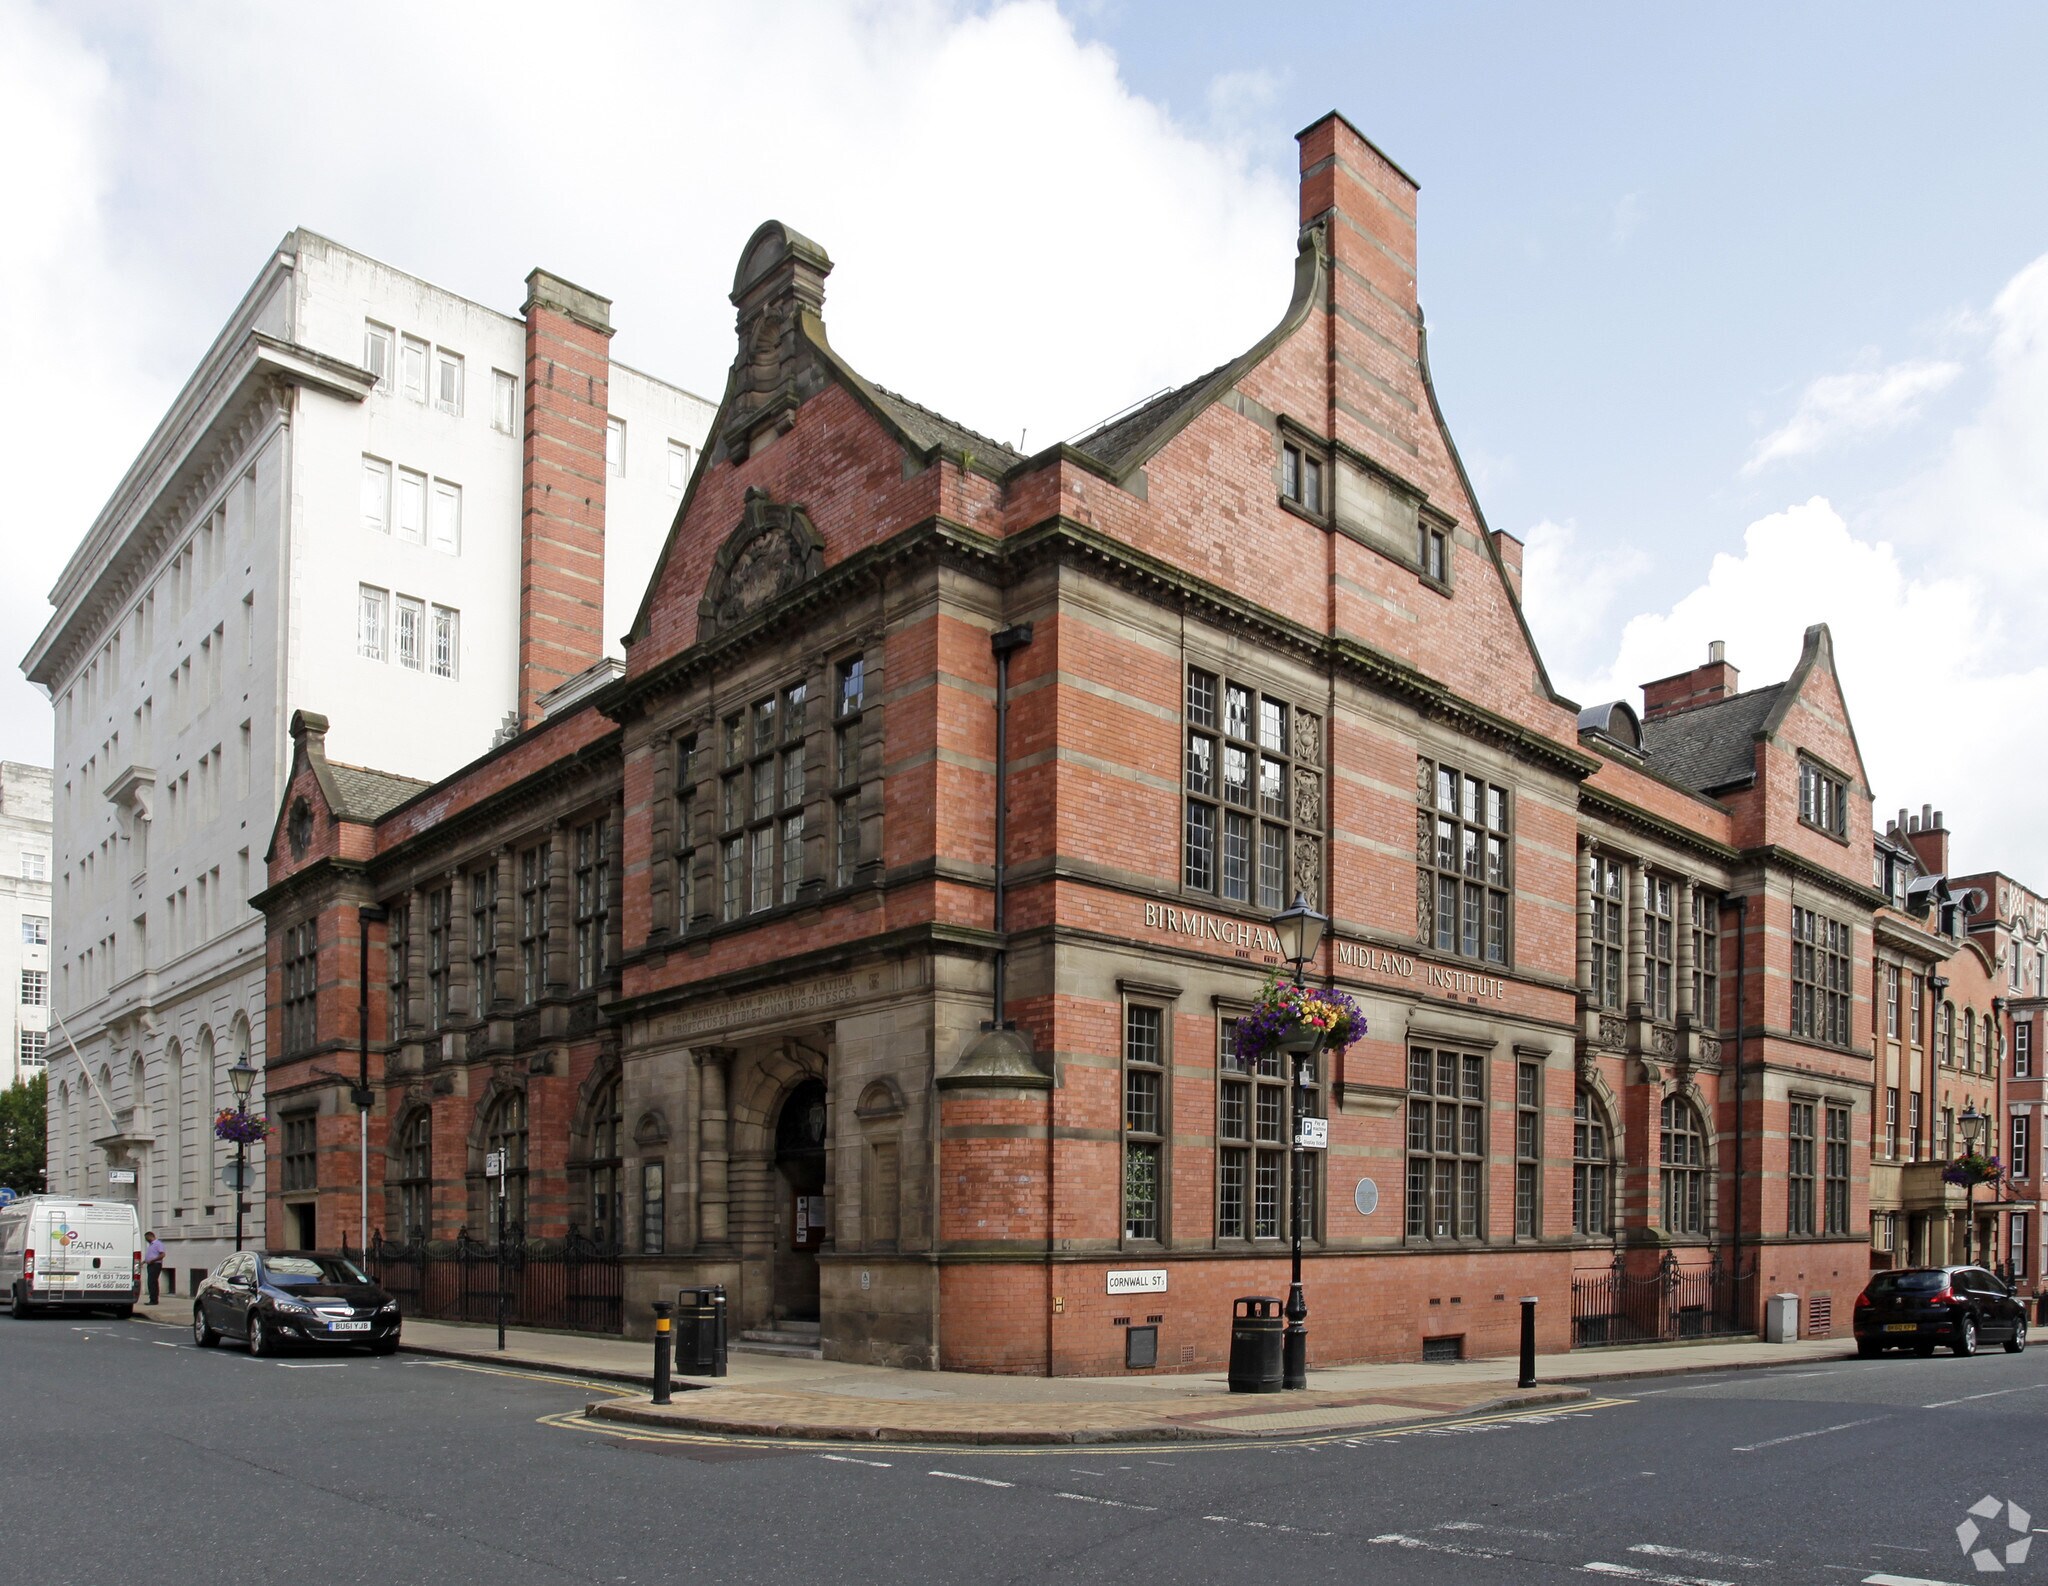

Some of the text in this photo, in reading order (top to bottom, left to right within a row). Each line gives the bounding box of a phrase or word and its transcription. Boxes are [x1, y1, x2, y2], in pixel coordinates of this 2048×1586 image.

[1145, 902, 1504, 1000] BIRMINGHAM MIDLAND INSTITUTE
[676, 975, 853, 1024] AD MERCATURAM BONARUM ARTIUM
[764, 997, 806, 1016] OMNIBUS
[809, 987, 857, 1006] DITESCES
[70, 1241, 114, 1250] FARINA
[1109, 1276, 1149, 1287] CORNWALL
[1152, 1276, 1161, 1285] ST
